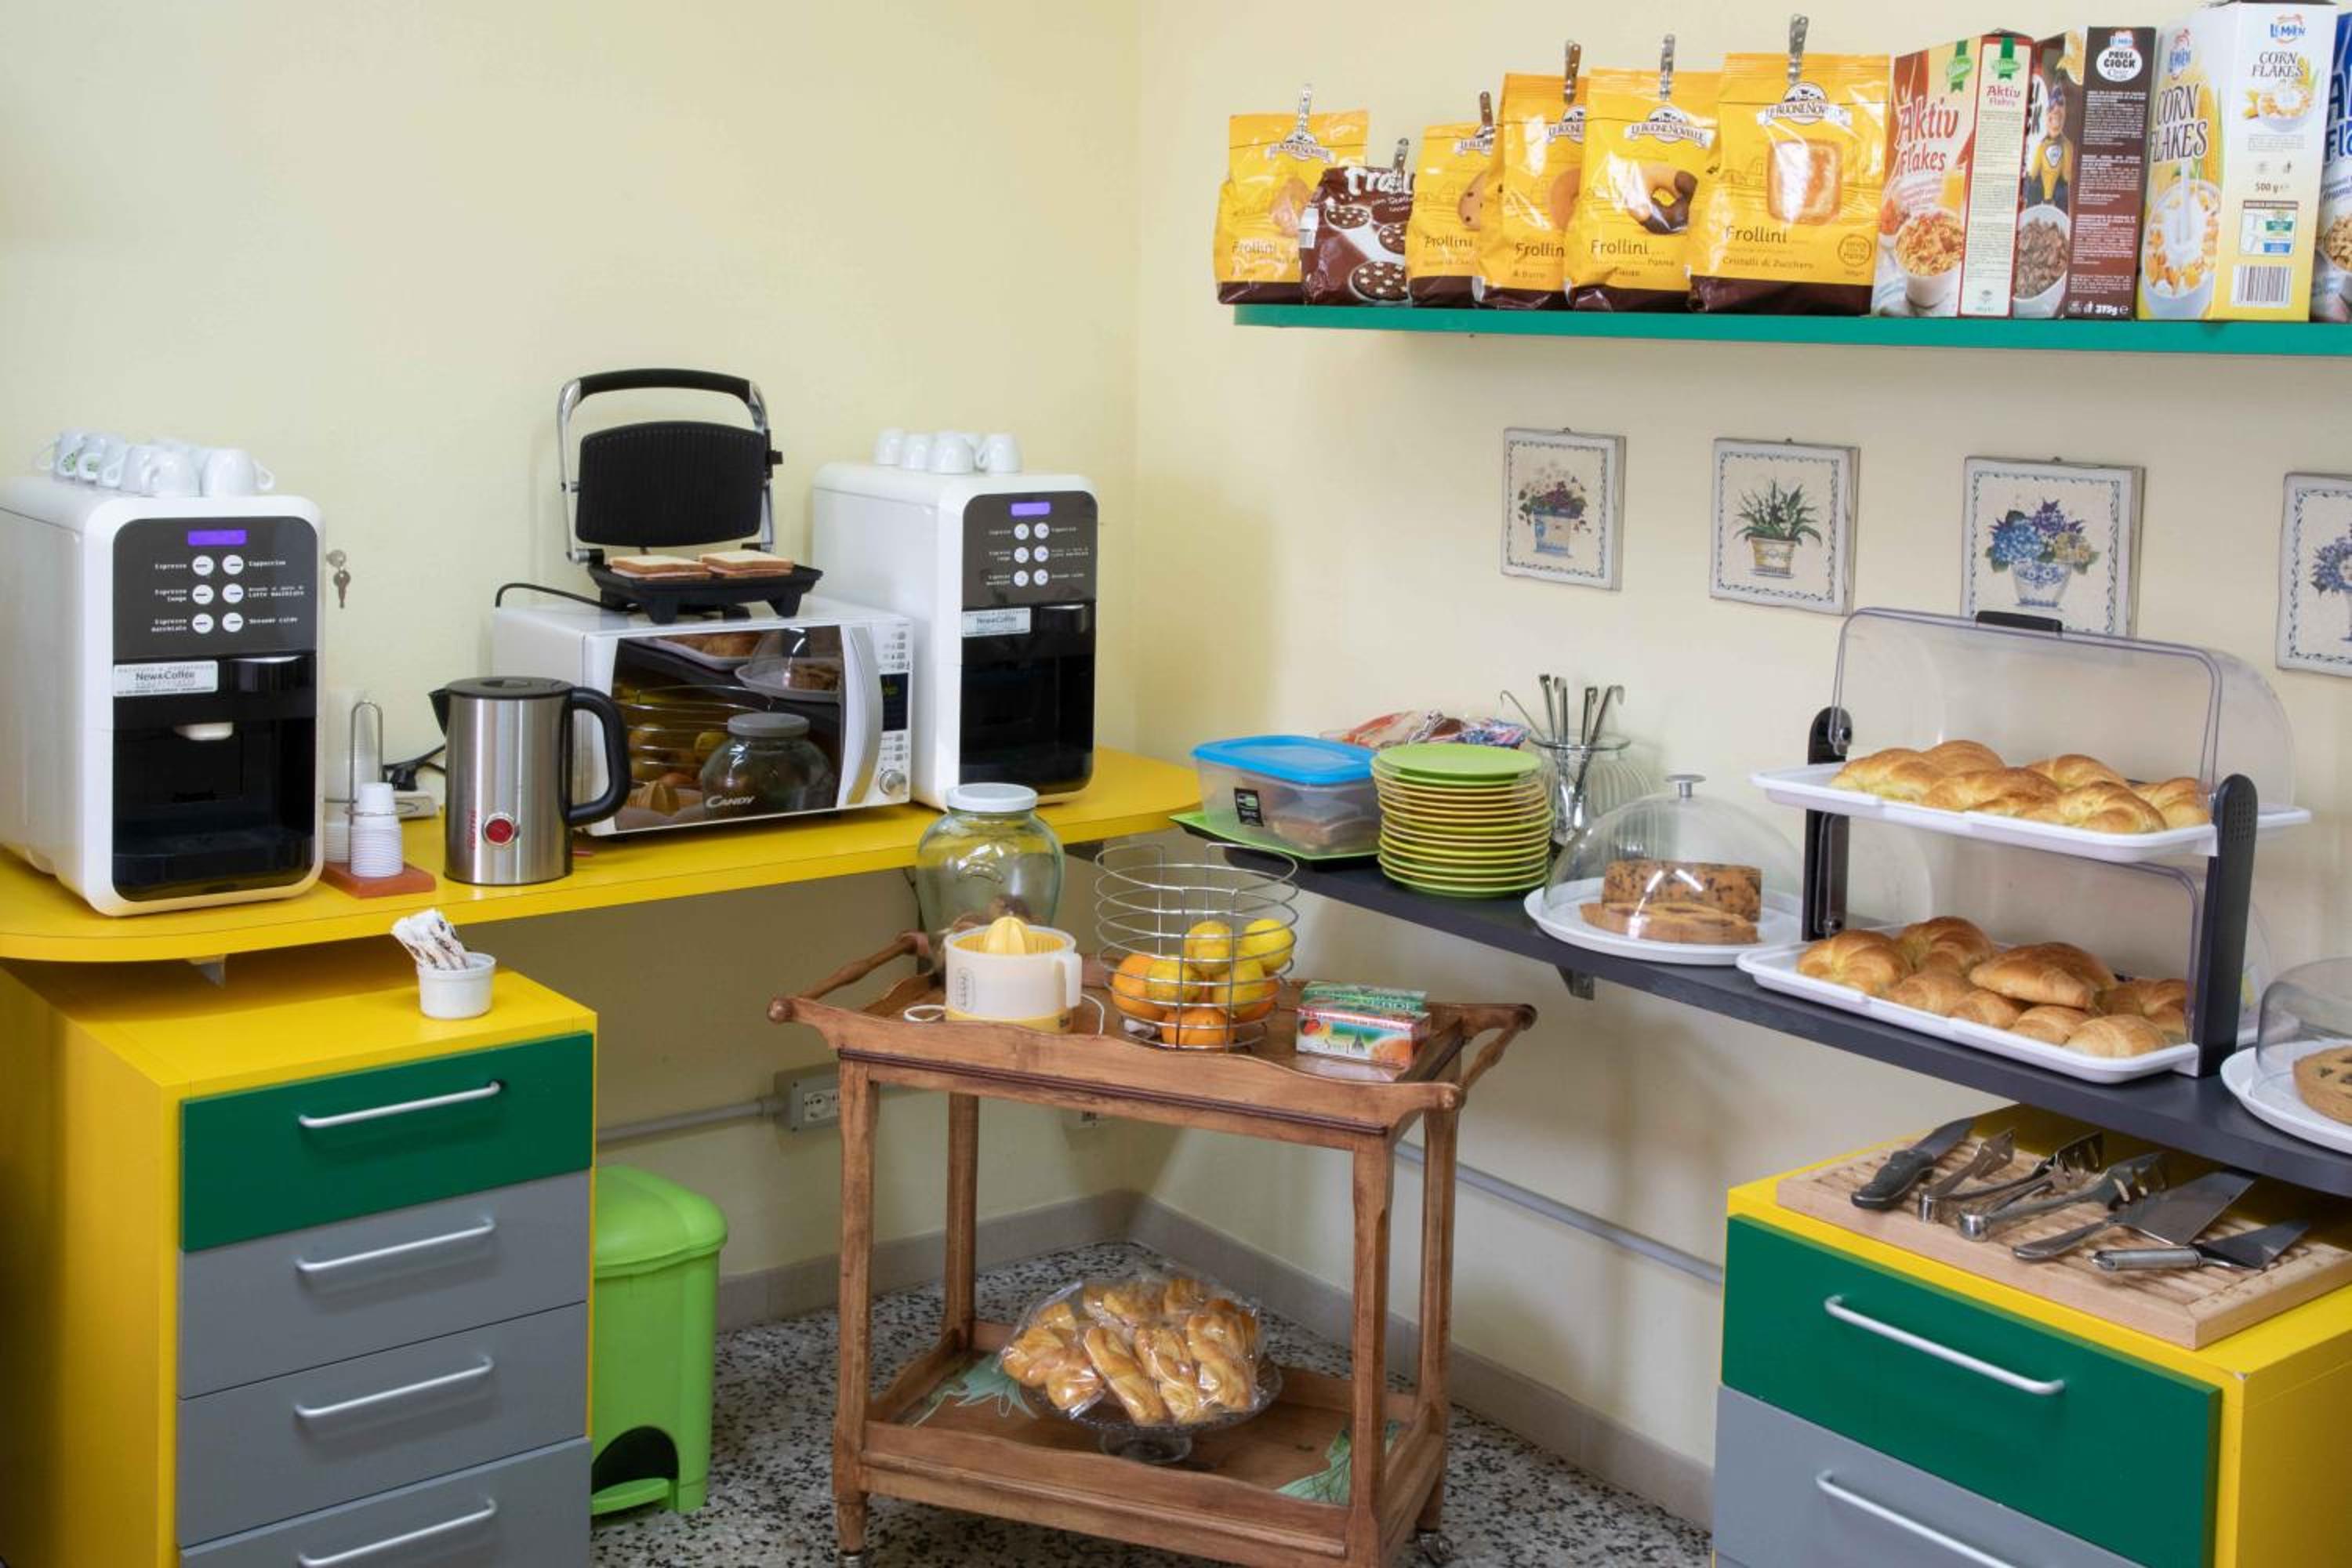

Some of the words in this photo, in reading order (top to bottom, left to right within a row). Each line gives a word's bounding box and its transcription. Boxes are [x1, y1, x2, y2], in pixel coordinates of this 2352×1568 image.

[2259, 51, 2297, 64] CORN
[2252, 64, 2303, 78] FLAKES
[1987, 85, 2020, 98] Aktiv
[2157, 83, 2199, 125] CORN
[1896, 98, 1959, 147] Aktiv
[2151, 121, 2208, 162] FLAKES
[1900, 143, 1946, 176] Flakes
[1424, 234, 1473, 249] Frollini
[1726, 225, 1788, 244] Frollini
[1515, 241, 1565, 259] Frollin
[1591, 238, 1649, 255] Frollini
